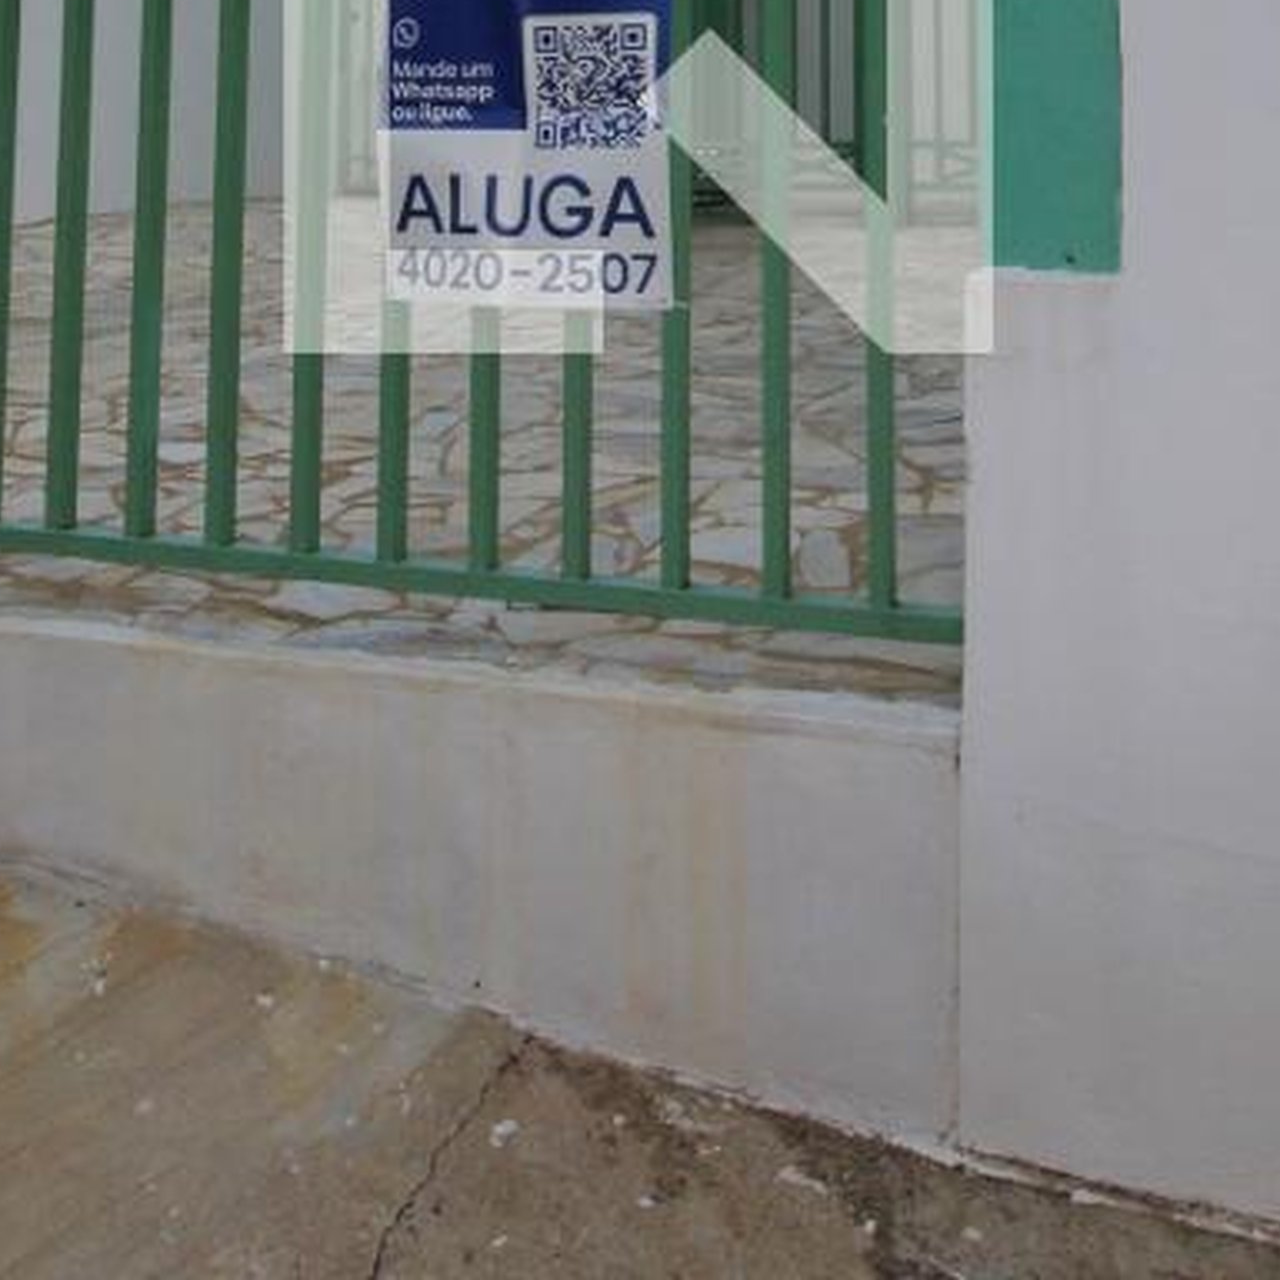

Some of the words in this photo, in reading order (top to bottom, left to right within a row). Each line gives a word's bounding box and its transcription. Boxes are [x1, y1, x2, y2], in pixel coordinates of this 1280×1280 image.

[461, 63, 494, 78] um
[392, 82, 495, 103] Whatsapp
[396, 173, 656, 238] ALUGA
[397, 246, 658, 294] 4020-2507
